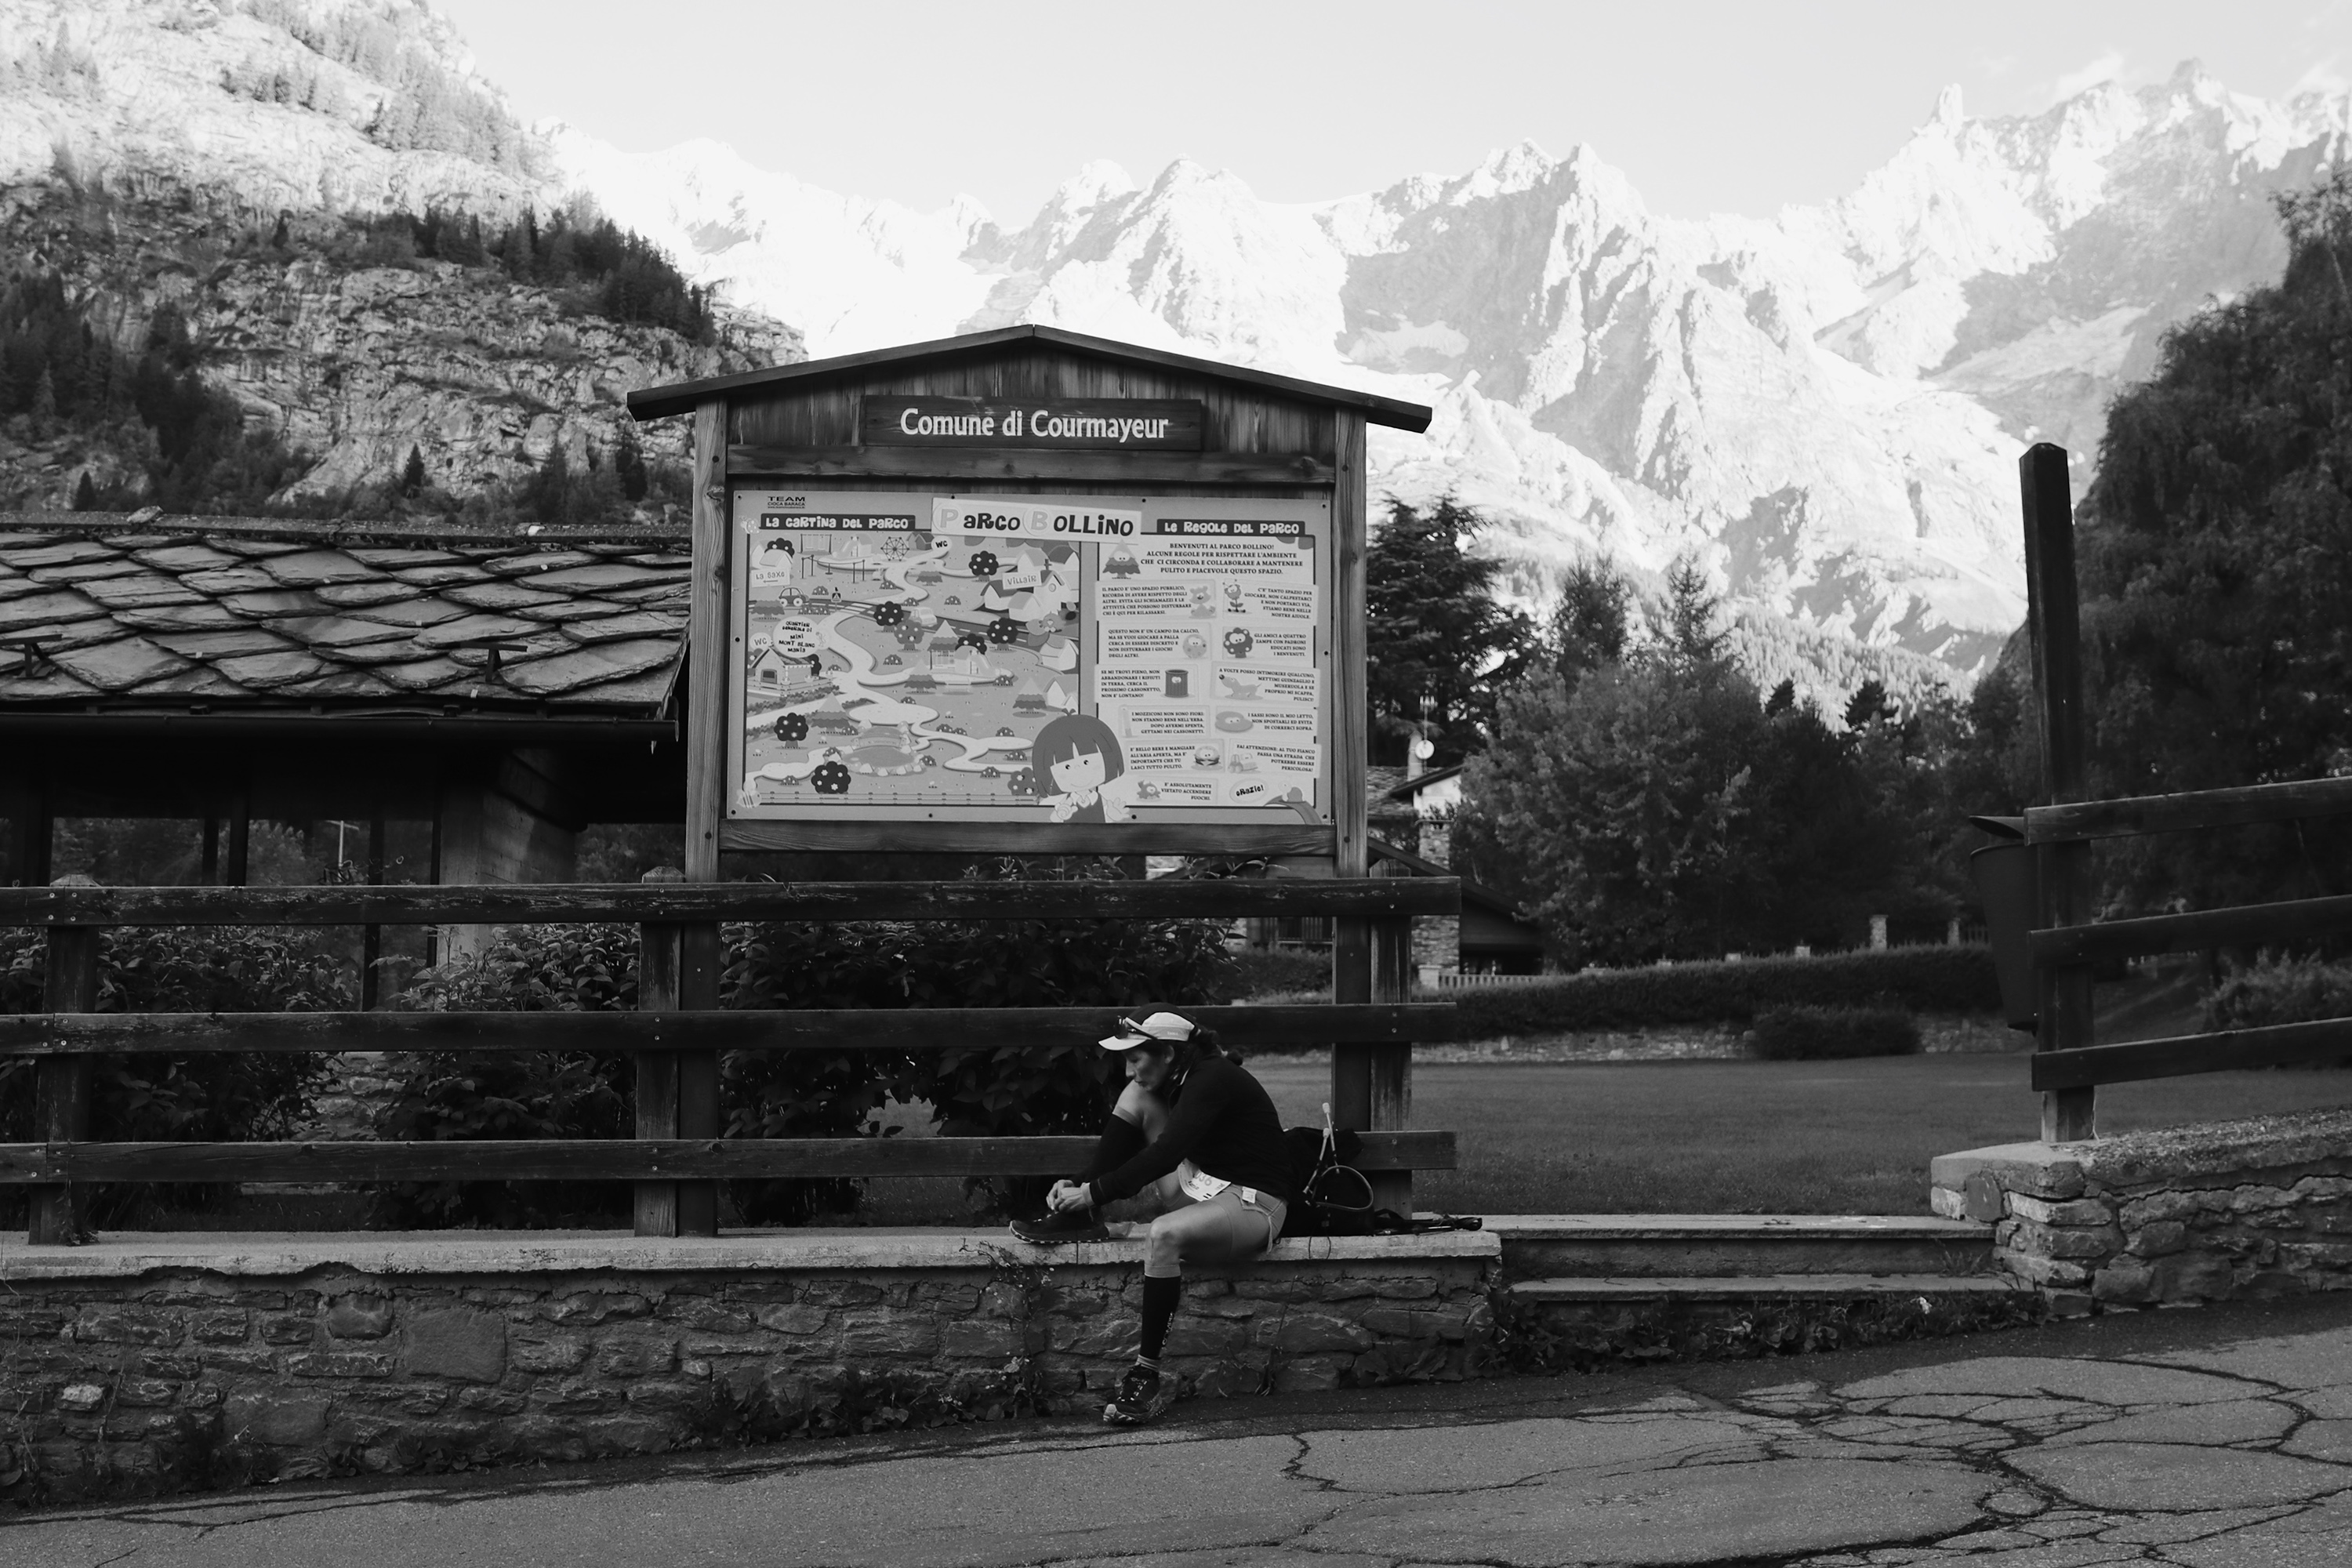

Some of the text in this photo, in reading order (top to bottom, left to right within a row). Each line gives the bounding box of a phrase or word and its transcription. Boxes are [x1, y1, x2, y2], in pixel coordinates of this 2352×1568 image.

[901, 408, 1169, 443] Comune di Courmayeur
